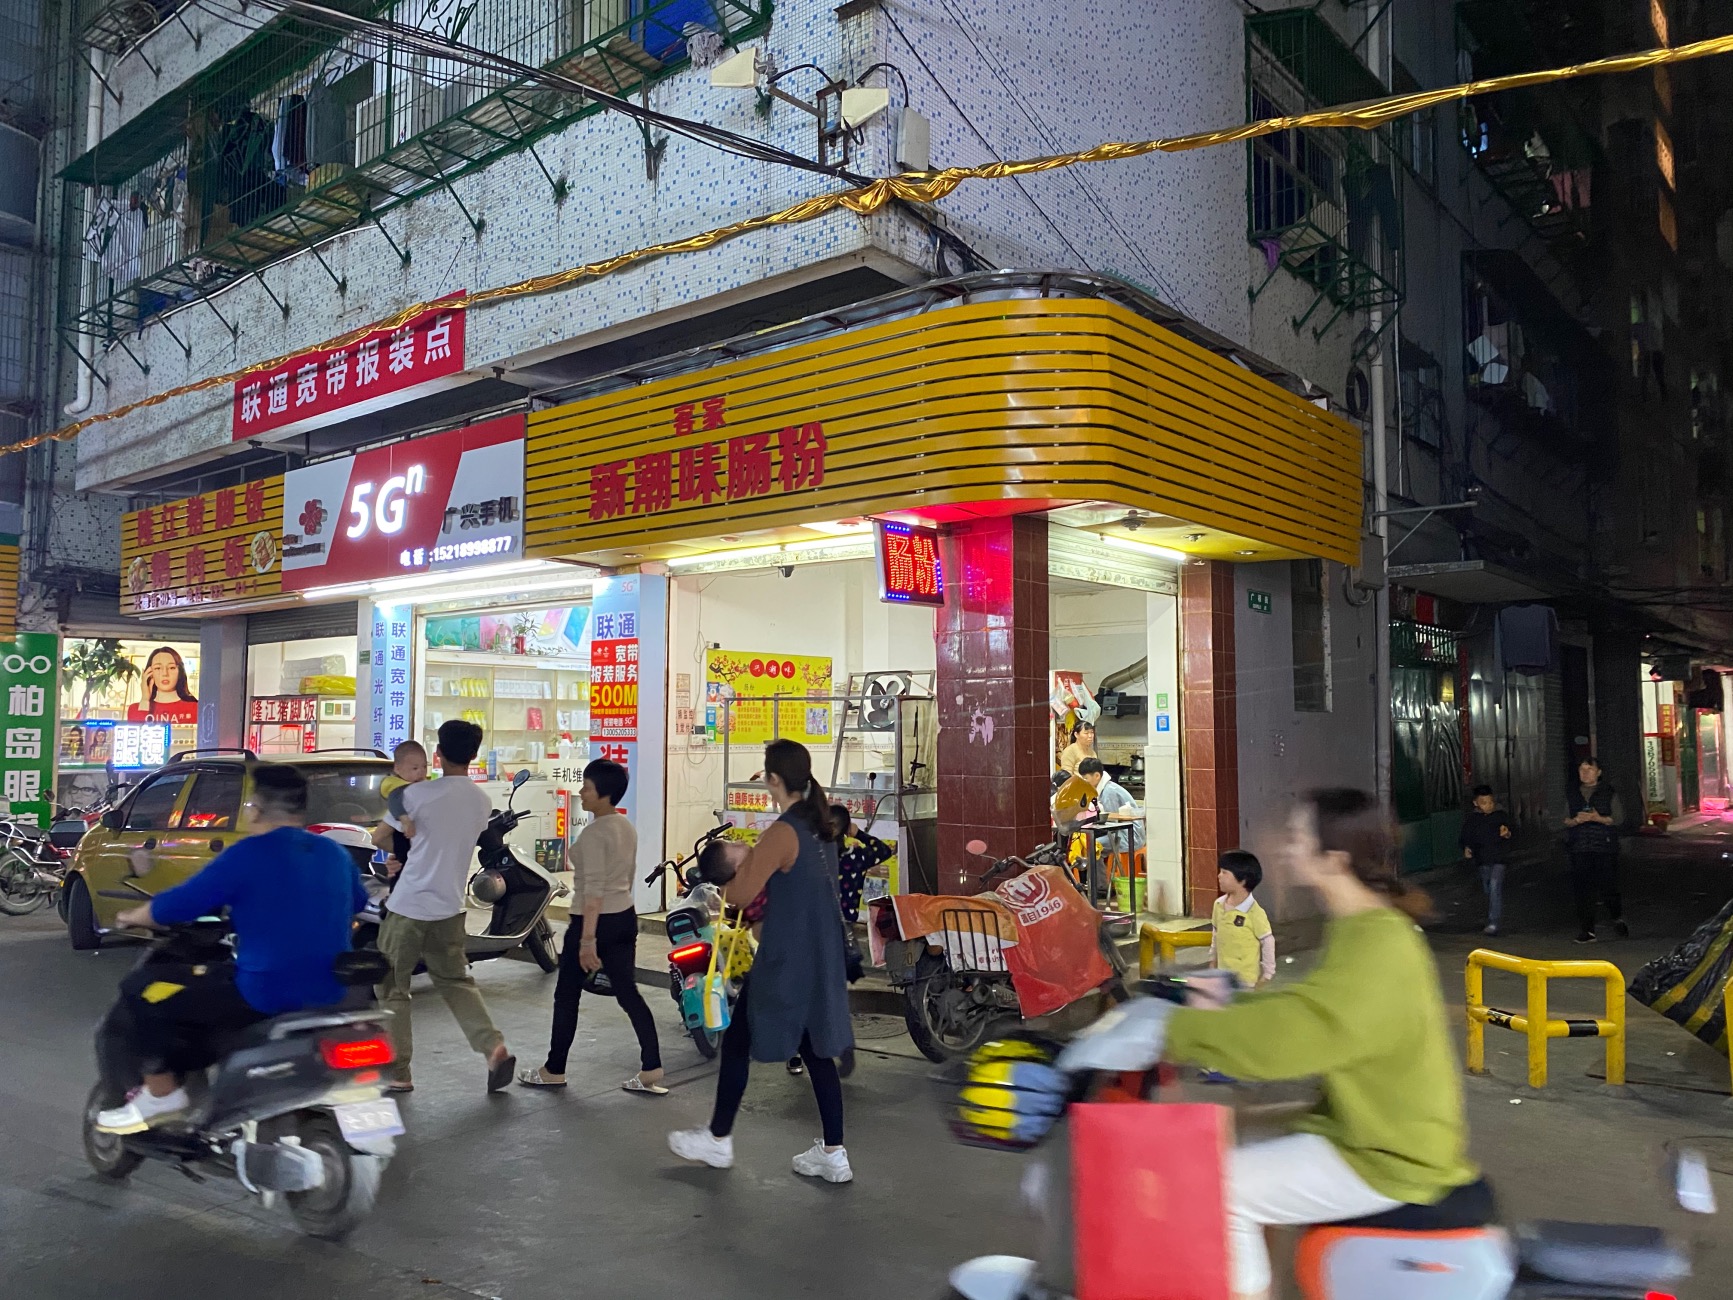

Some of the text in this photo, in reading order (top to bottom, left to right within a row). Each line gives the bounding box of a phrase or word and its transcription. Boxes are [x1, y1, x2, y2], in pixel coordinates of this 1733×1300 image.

[241, 314, 452, 424] 联通宽带报装点
[673, 397, 727, 437] 客家
[588, 421, 828, 520] 新潮味肠粉
[442, 496, 519, 534] 广兴手机
[886, 533, 939, 594] 肠粉
[596, 612, 635, 639] 联通
[615, 644, 638, 662] 宽带
[373, 622, 384, 748] 联通光纤宽
[591, 664, 638, 683] 报装服务
[590, 684, 638, 707] 500M
[114, 725, 164, 764] 眼镜
